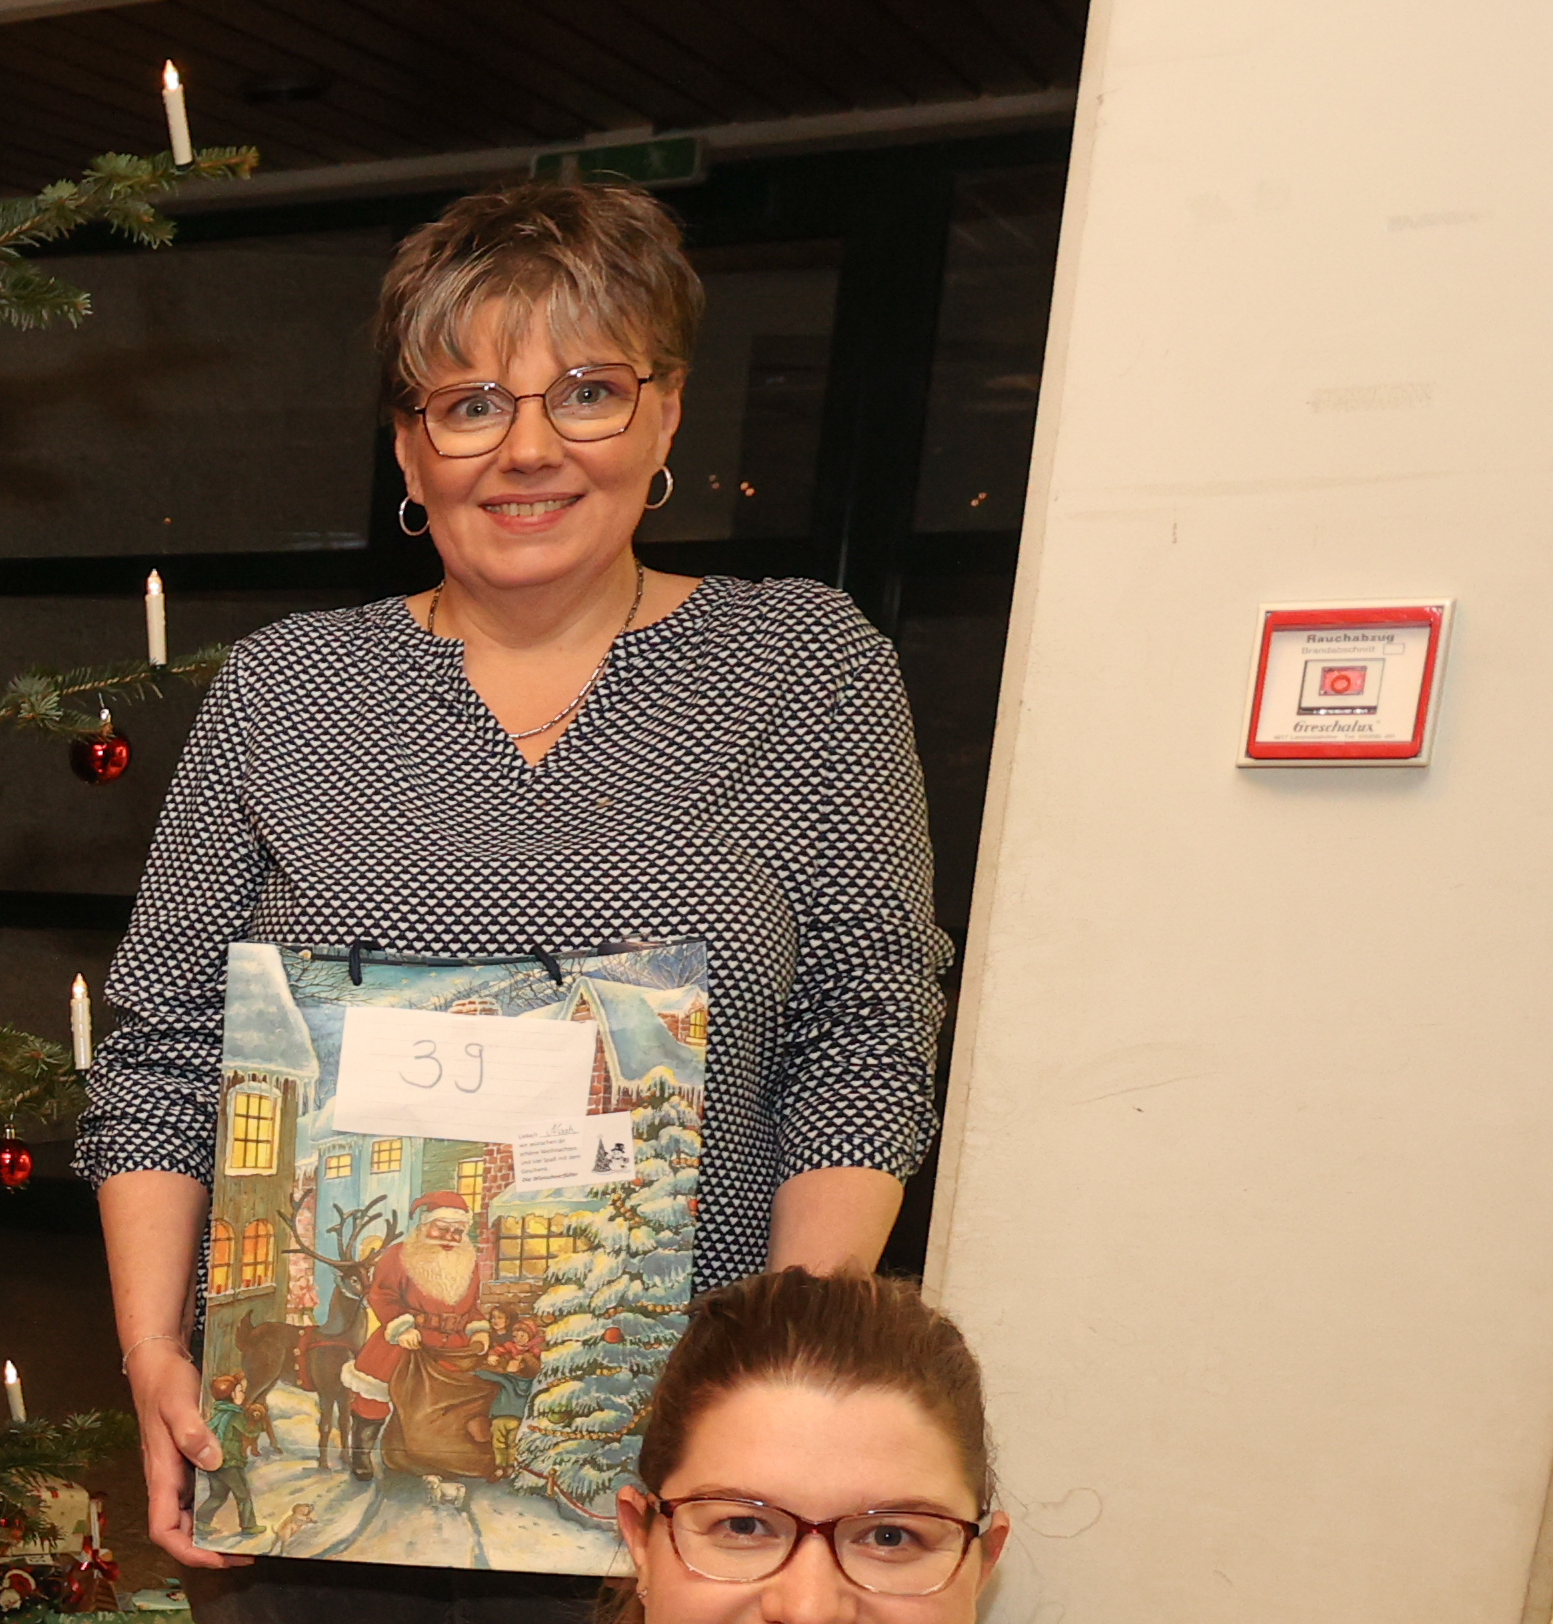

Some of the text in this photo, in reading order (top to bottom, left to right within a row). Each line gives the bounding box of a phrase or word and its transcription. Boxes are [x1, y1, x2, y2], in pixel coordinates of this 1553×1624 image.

[1306, 633, 1394, 644] Rauchabzug
[1293, 720, 1374, 733] Greschalux
[398, 1039, 485, 1096] 39
